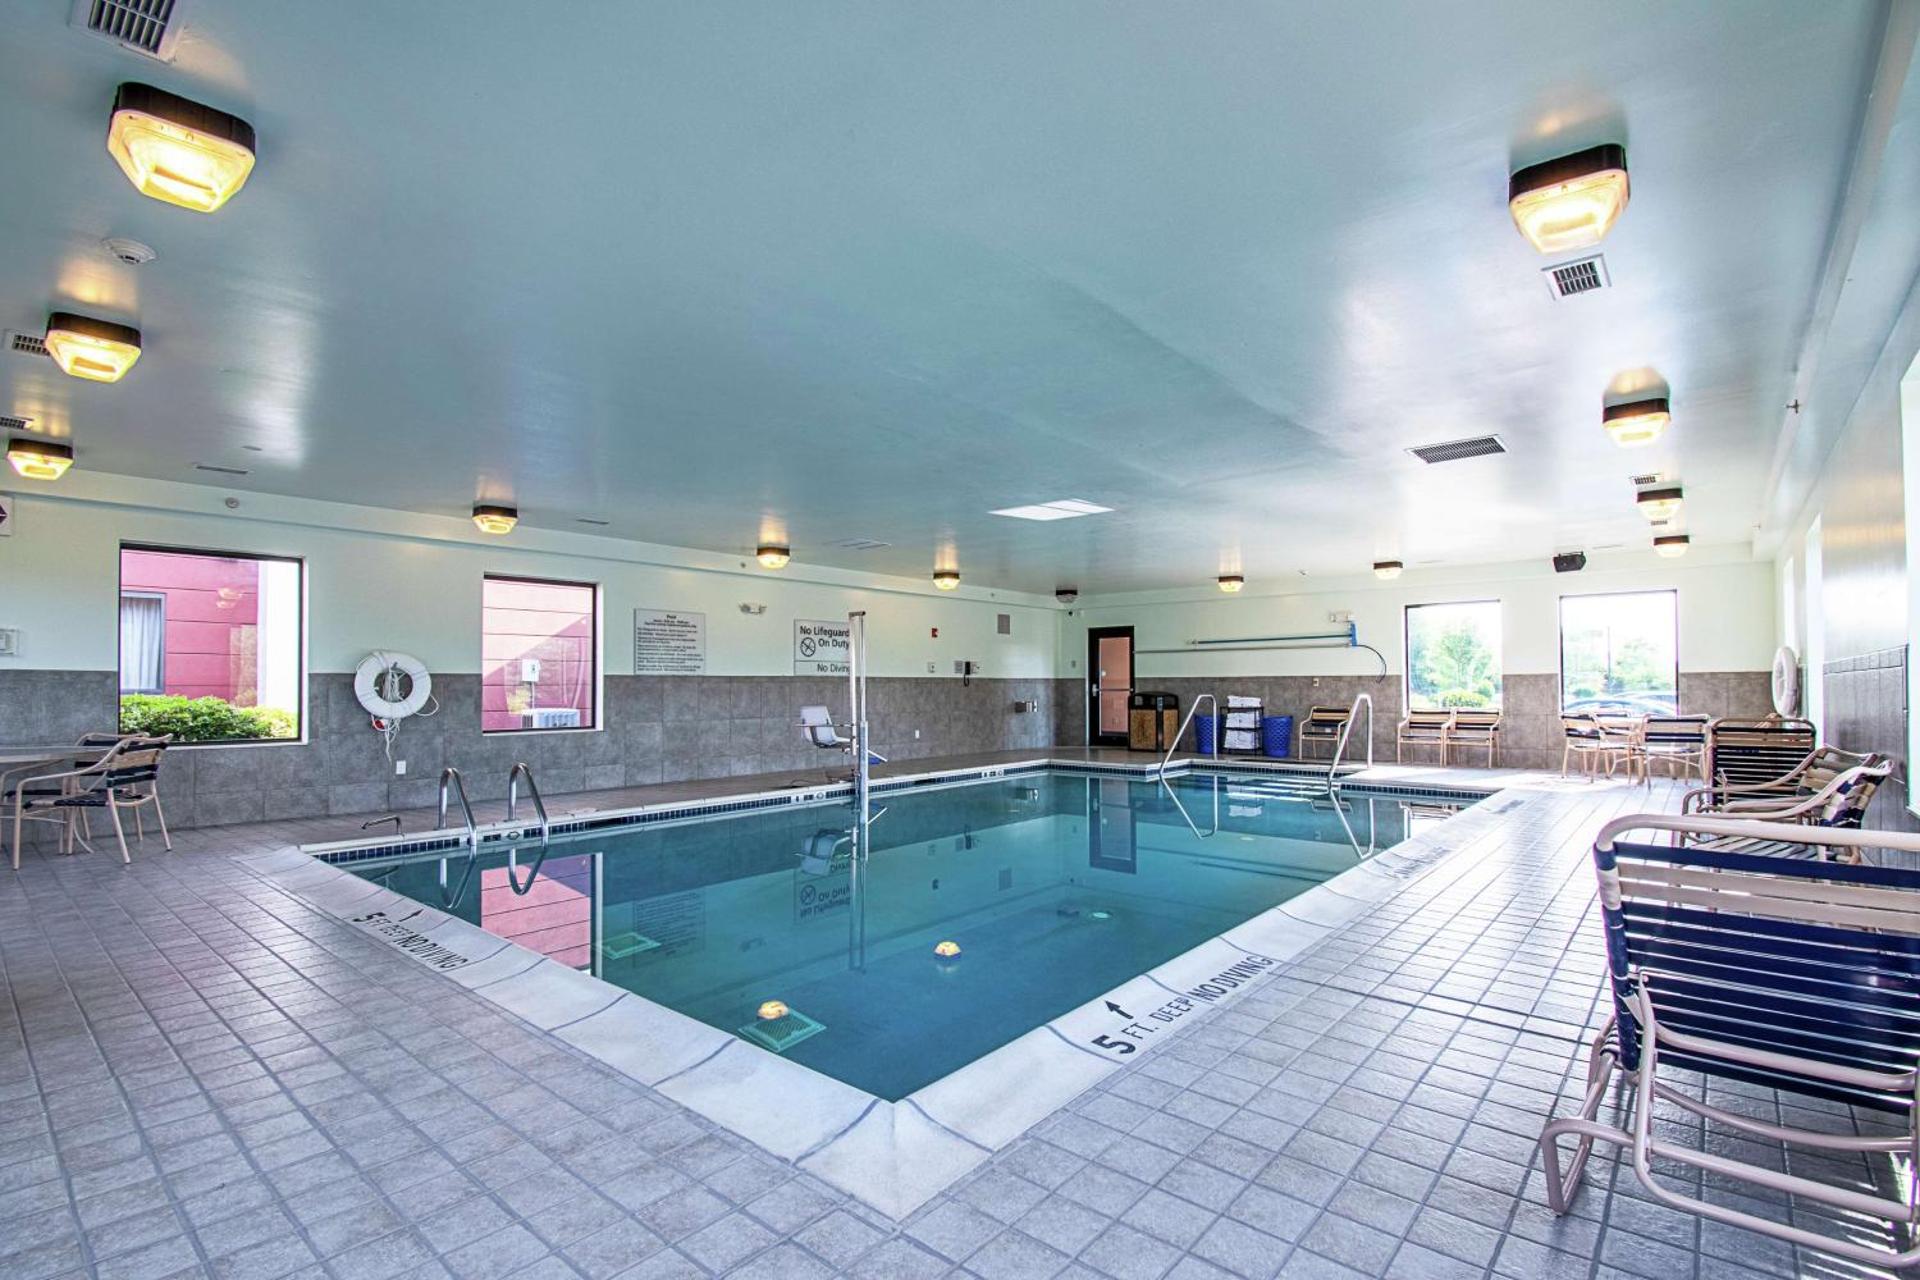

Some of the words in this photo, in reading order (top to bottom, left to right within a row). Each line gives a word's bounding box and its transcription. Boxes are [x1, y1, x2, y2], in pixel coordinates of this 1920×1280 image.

[800, 625, 812, 635] No
[814, 626, 850, 638] Lifeguard
[818, 638, 830, 647] On
[832, 639, 849, 650] Duty
[817, 663, 828, 672] No
[352, 912, 386, 922] 5
[393, 933, 429, 948] NO
[409, 942, 468, 969] DIVING
[1092, 1034, 1136, 1054] 5
[1149, 996, 1196, 1023] DEEP
[1187, 983, 1228, 1002] NO
[1211, 955, 1275, 989] DIVING
